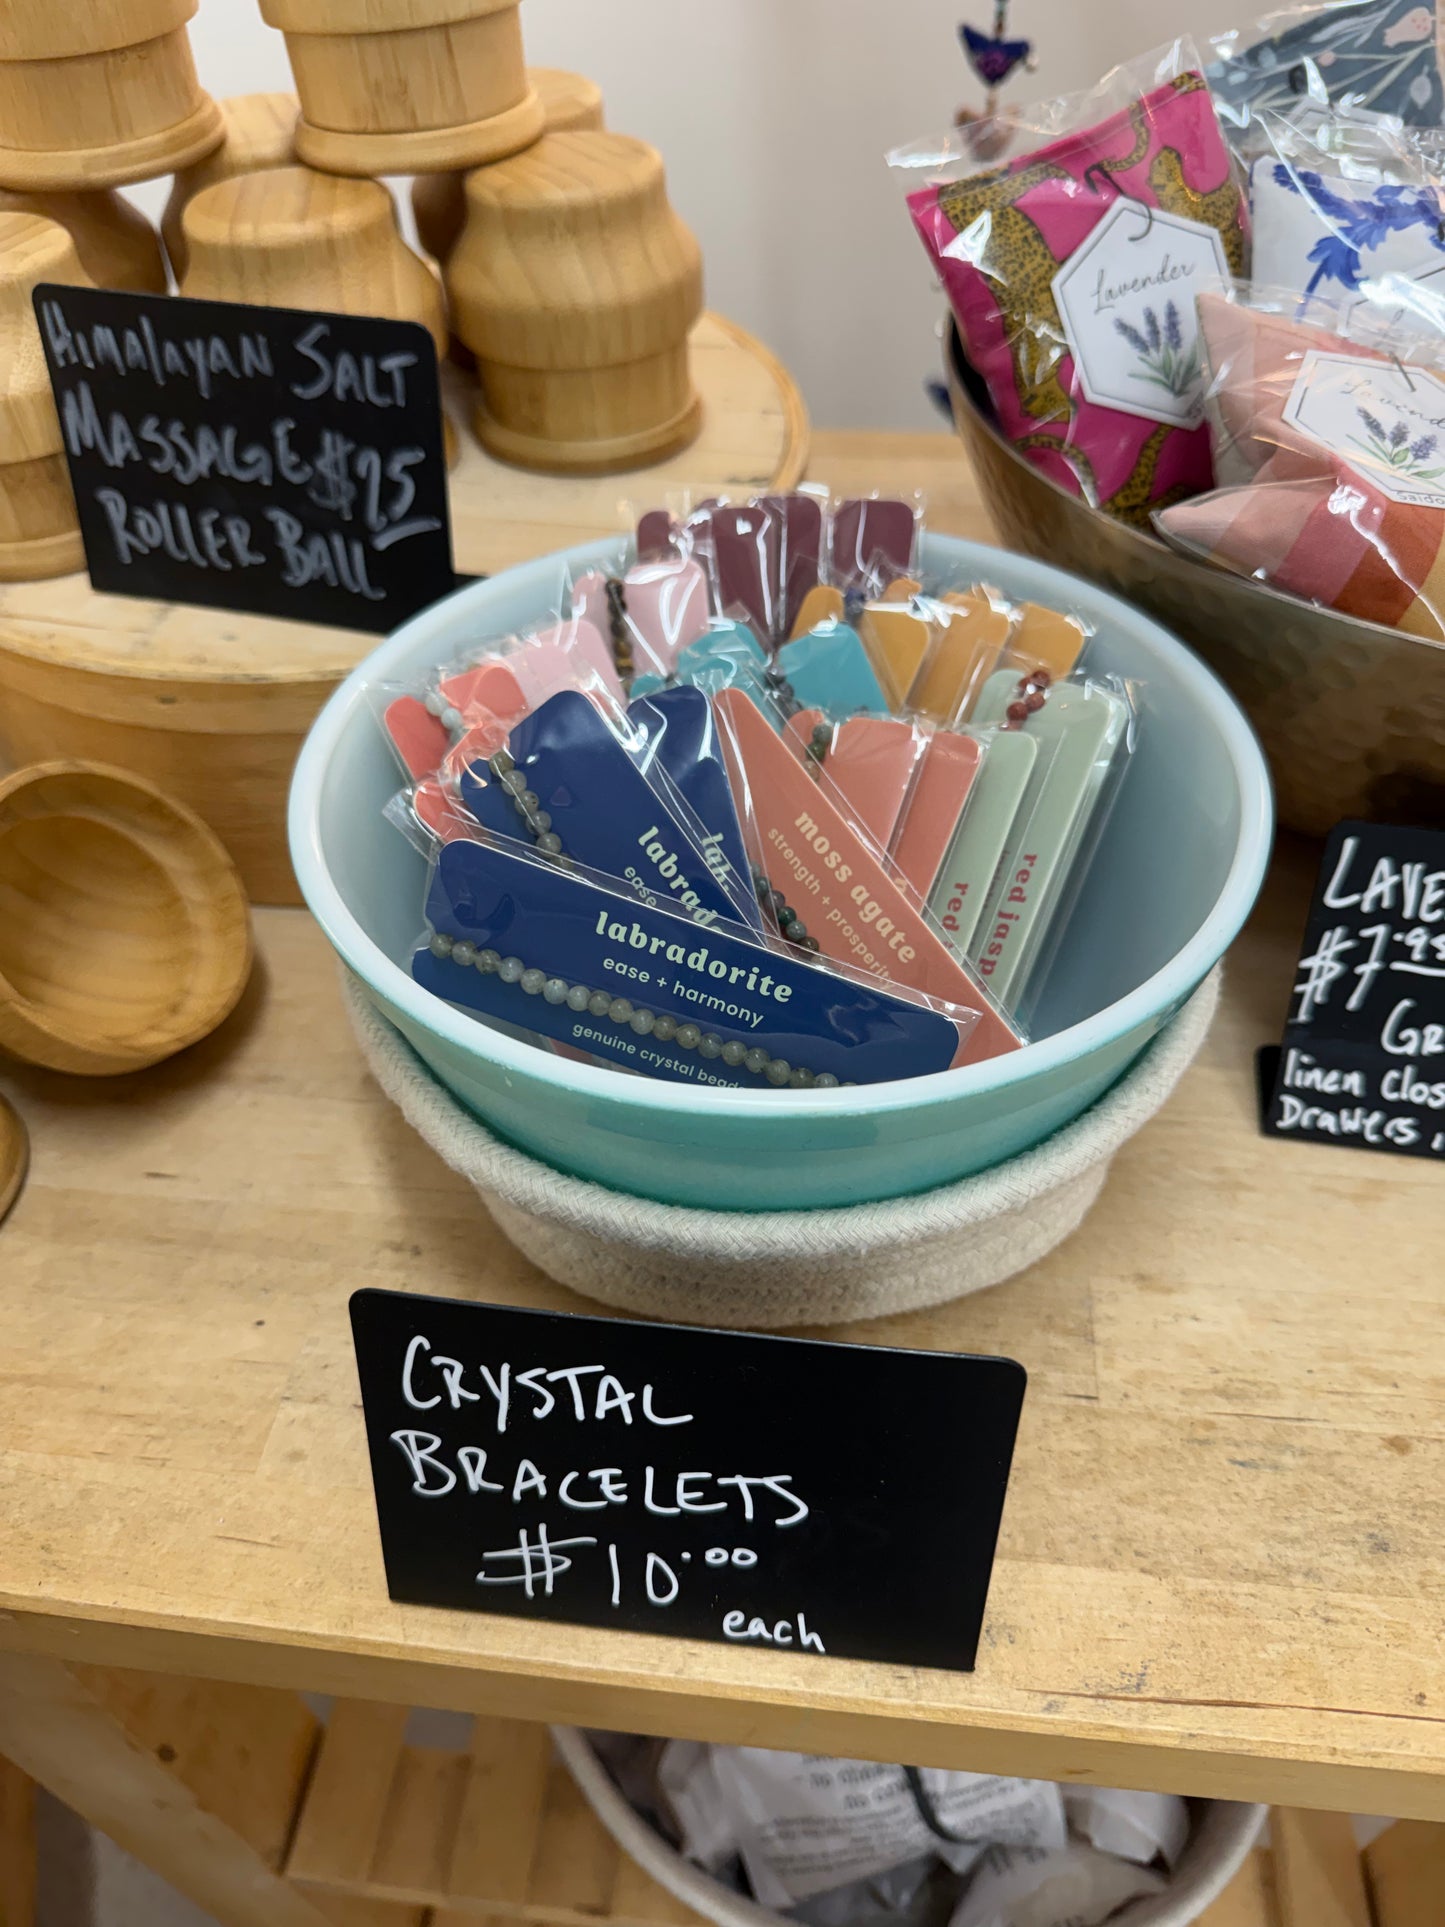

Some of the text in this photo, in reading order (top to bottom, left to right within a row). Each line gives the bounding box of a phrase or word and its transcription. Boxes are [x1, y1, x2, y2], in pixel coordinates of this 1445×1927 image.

[1090, 254, 1195, 314] Lavender
[292, 323, 418, 408] SALT
[62, 382, 427, 533] MASSAGE $25
[96, 488, 387, 600] ROLLER BALL
[624, 866, 657, 907] ease
[768, 828, 823, 899] strength
[794, 812, 916, 963] moss agate
[942, 882, 969, 932] red
[977, 854, 1038, 992] red jasp
[595, 911, 793, 1003] labradorite
[603, 957, 651, 983] ease
[673, 981, 765, 1029] harmony
[572, 1022, 637, 1055] genuine
[640, 1048, 696, 1078] crystal
[402, 1335, 694, 1432] CRYSTAL
[390, 1430, 810, 1527] BRACELETS
[722, 1609, 826, 1653] each
